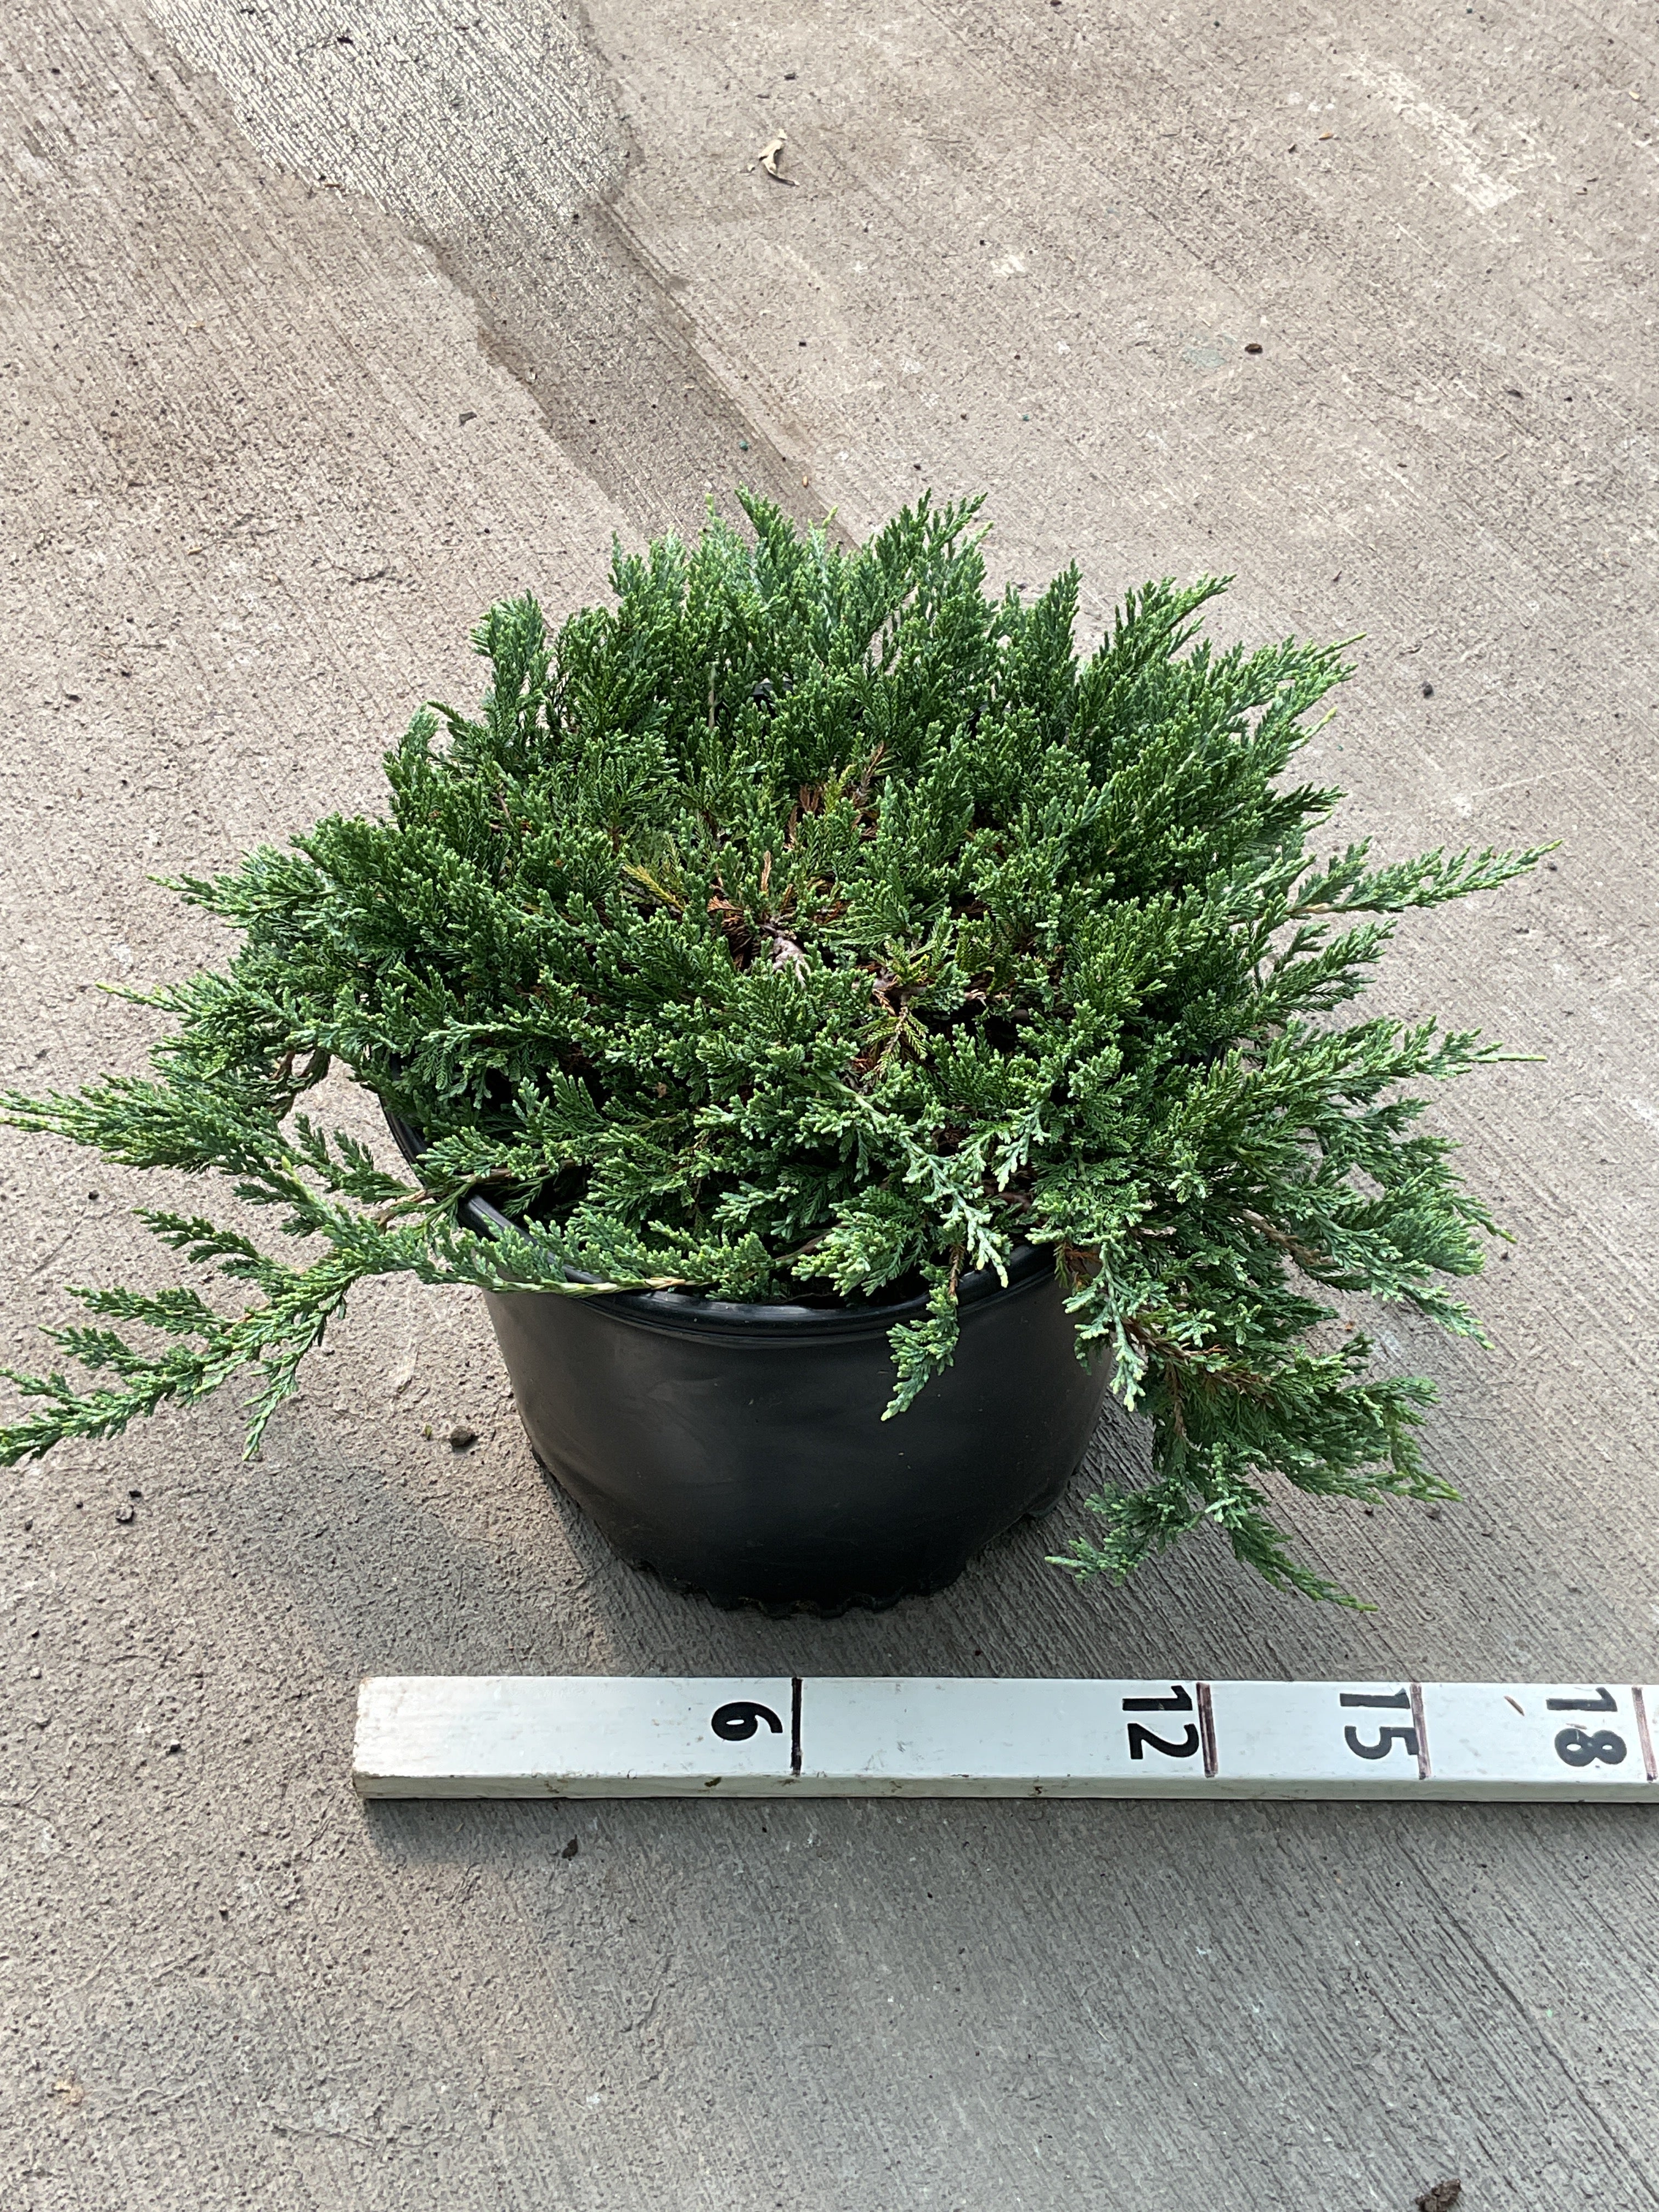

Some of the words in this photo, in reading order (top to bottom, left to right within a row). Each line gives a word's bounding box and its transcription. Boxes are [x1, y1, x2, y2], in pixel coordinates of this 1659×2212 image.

[711, 1701, 783, 1741] 6
[1122, 1685, 1199, 1759] 12
[1339, 1688, 1419, 1760] 15
[1546, 1687, 1627, 1767] 18
